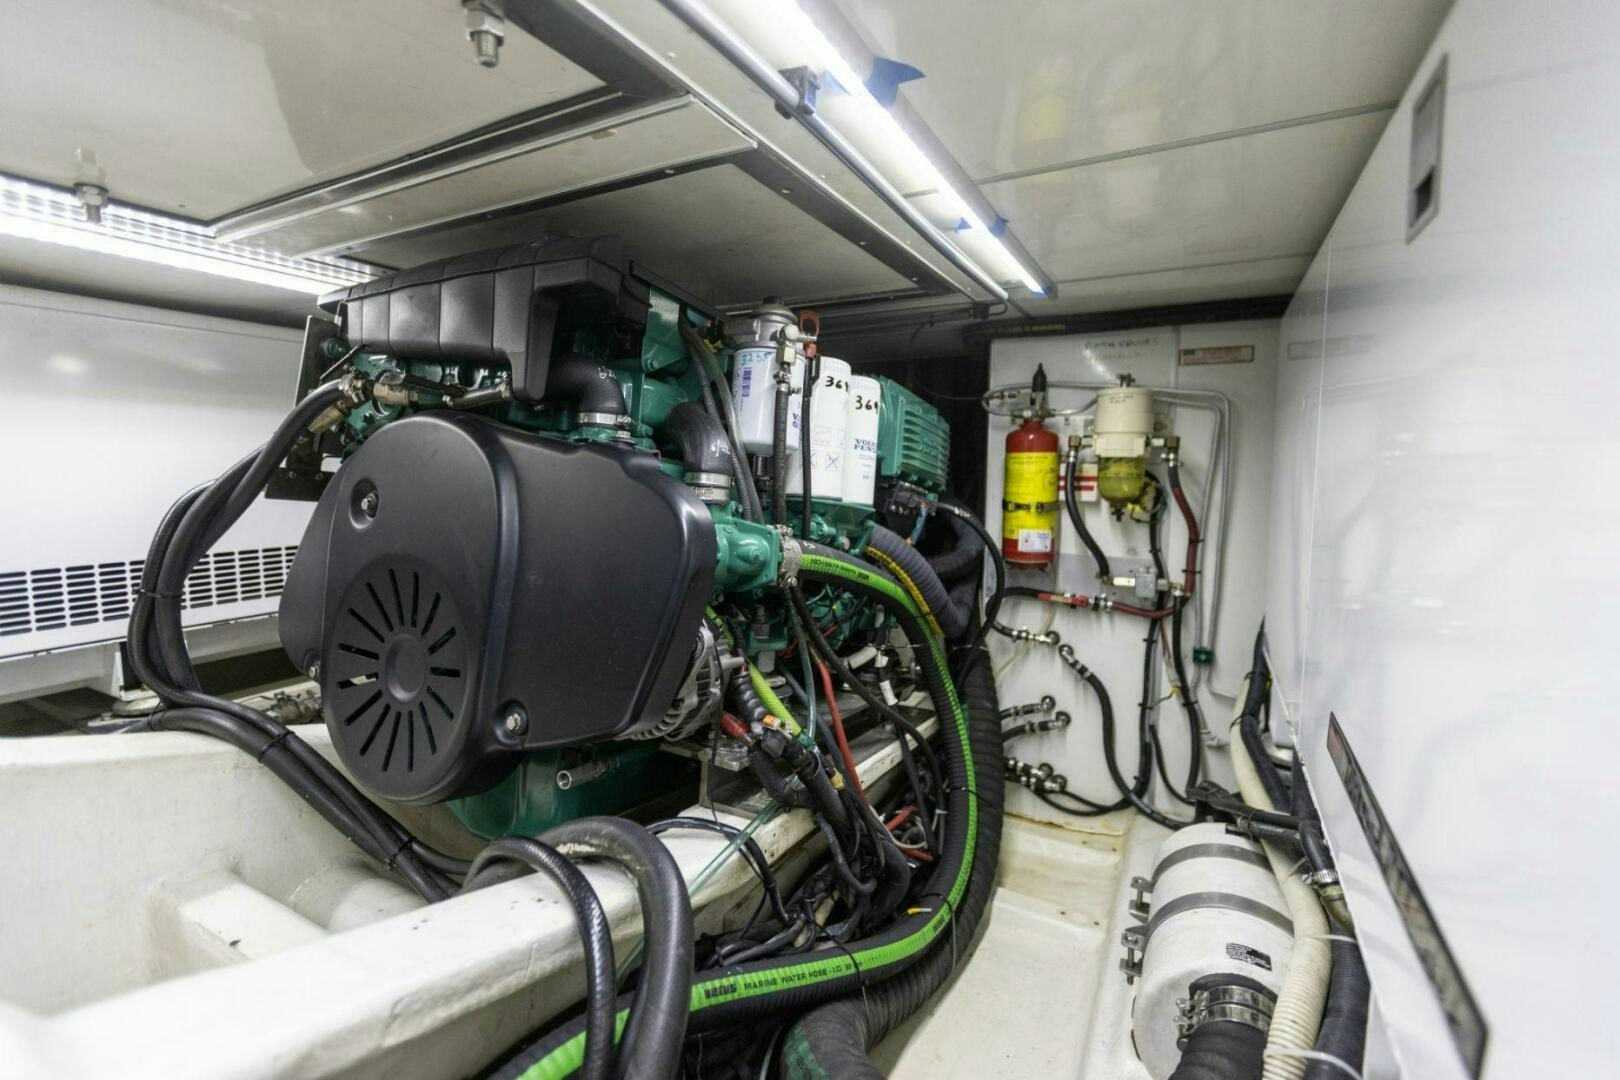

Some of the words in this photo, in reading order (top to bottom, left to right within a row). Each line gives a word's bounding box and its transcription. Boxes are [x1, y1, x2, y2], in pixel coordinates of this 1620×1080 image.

[743, 979, 778, 990] MARINE
[781, 974, 807, 985] WATER
[808, 968, 828, 979] HOSE
